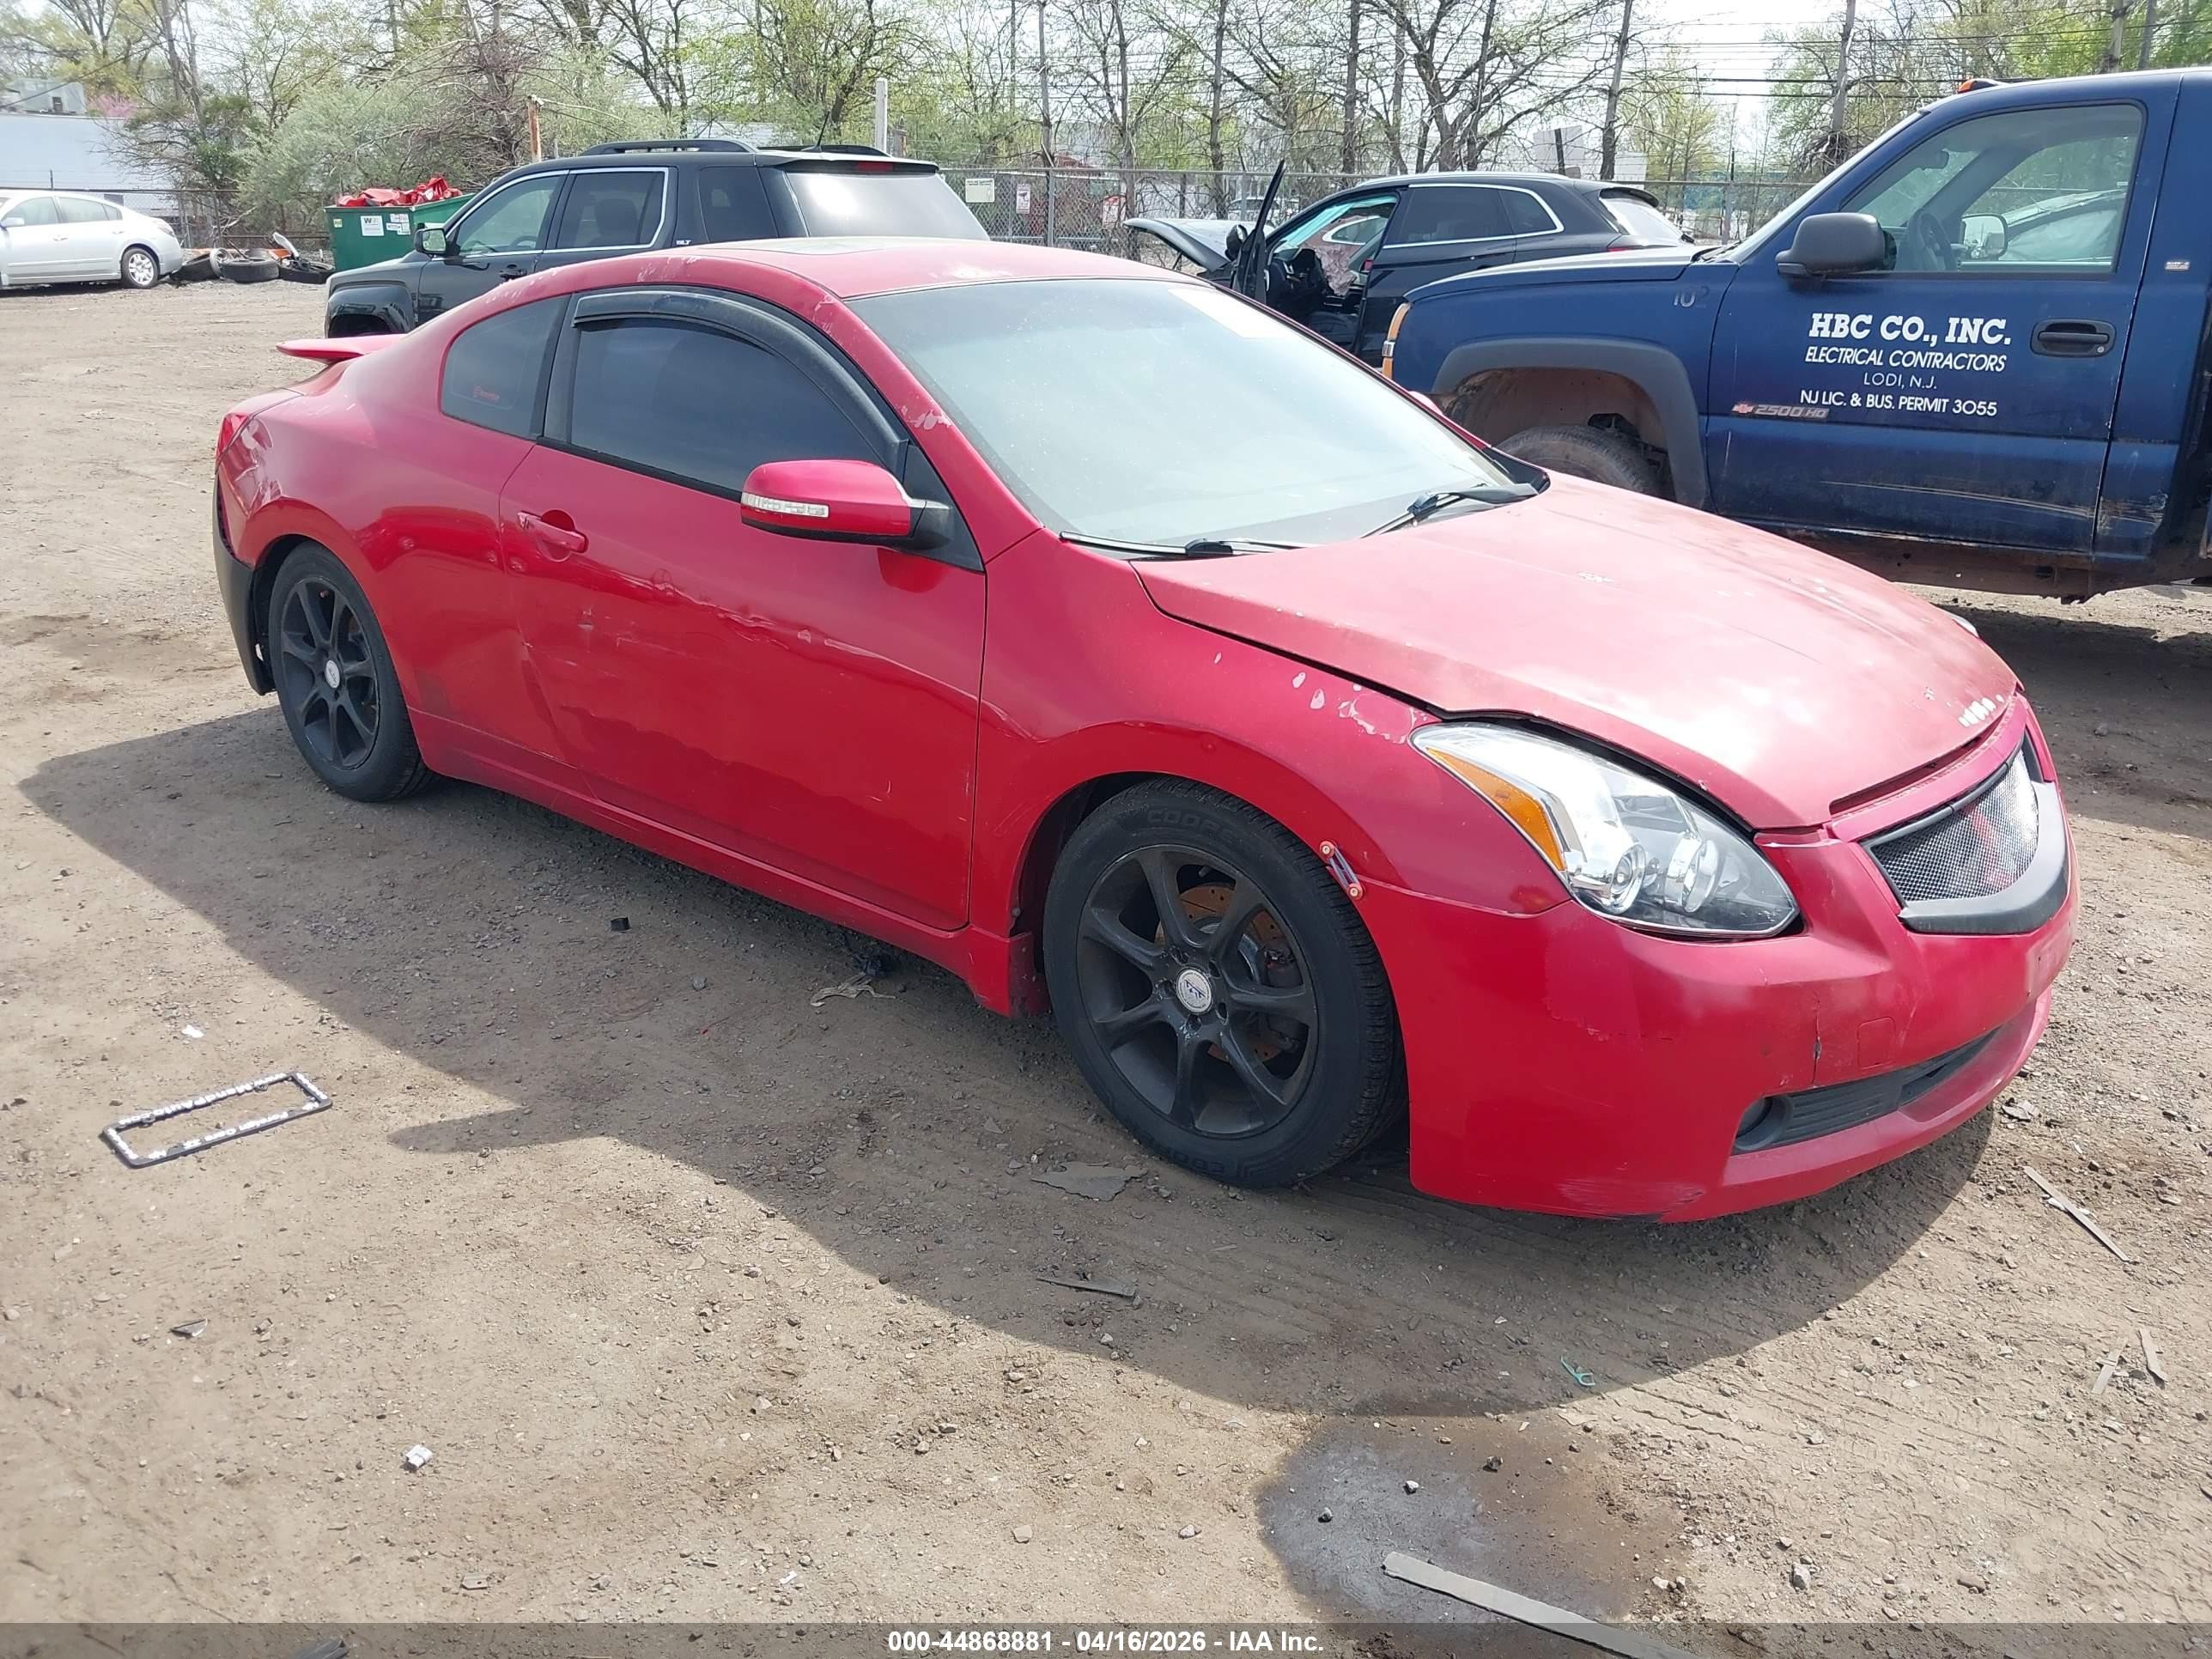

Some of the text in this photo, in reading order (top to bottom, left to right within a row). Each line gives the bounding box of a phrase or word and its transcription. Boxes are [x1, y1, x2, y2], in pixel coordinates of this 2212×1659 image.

[1808, 313, 2011, 347] HBC CO., INC.
[1805, 346, 2007, 372] ELECTRICAL CONTRACTORS
[1863, 372, 1937, 389] LODI, N.J.
[1754, 404, 1802, 417] 2500
[1800, 389, 1997, 416] NJ LIC. & BUS. PERMIT 3055
